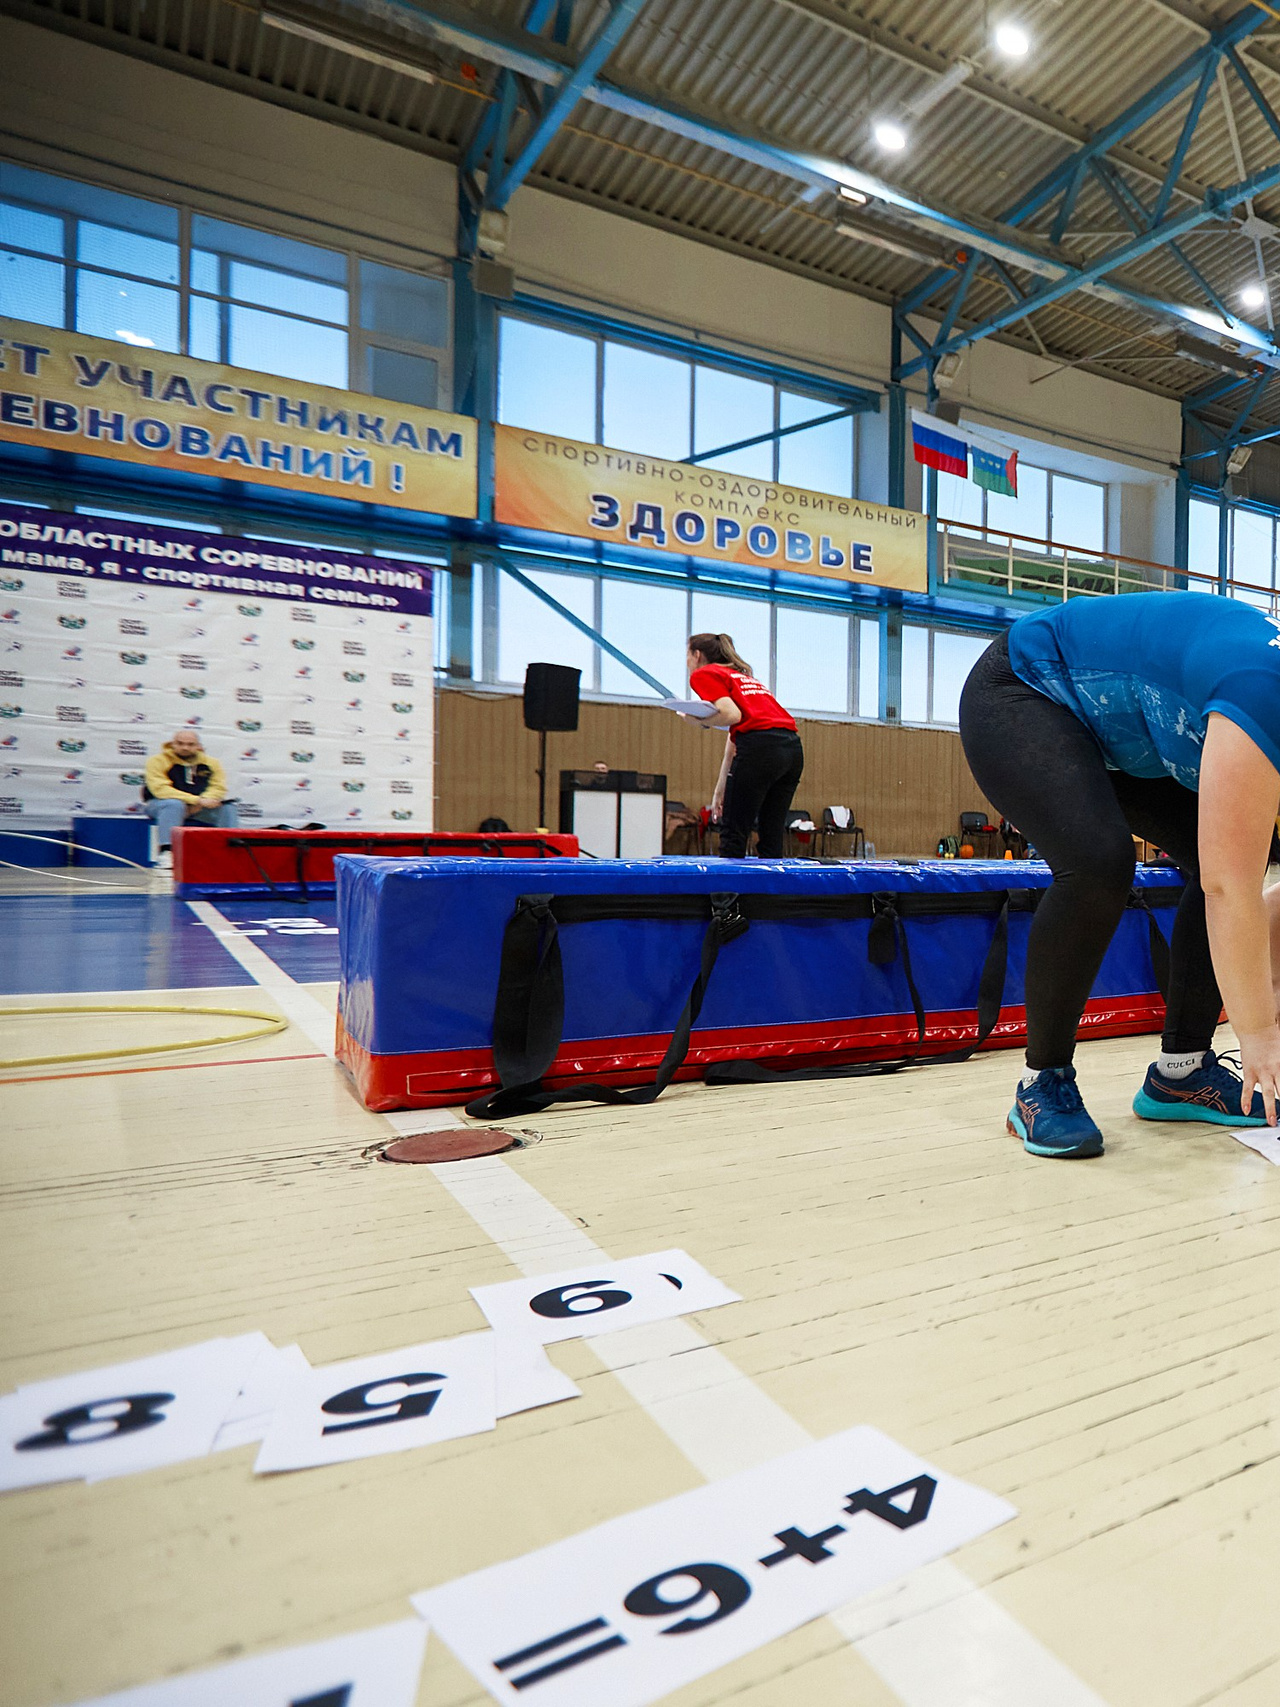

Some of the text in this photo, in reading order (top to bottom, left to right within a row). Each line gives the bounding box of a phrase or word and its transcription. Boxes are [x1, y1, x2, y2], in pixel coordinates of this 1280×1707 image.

[0, 338, 464, 459] Т УЧАСТНИКАМ
[0, 519, 424, 590] ОБЛАСТНЫХ СОРЕВНОВАНИЙ
[589, 494, 874, 573] ЗДОРОВЬЕ
[1, 549, 95, 575] мама,
[101, 561, 121, 576] я
[142, 566, 305, 598] спортивная
[308, 586, 400, 607] семья»
[14, 1392, 176, 1451] 8
[321, 1371, 448, 1436] 5
[493, 1474, 939, 1691] 4+6=
